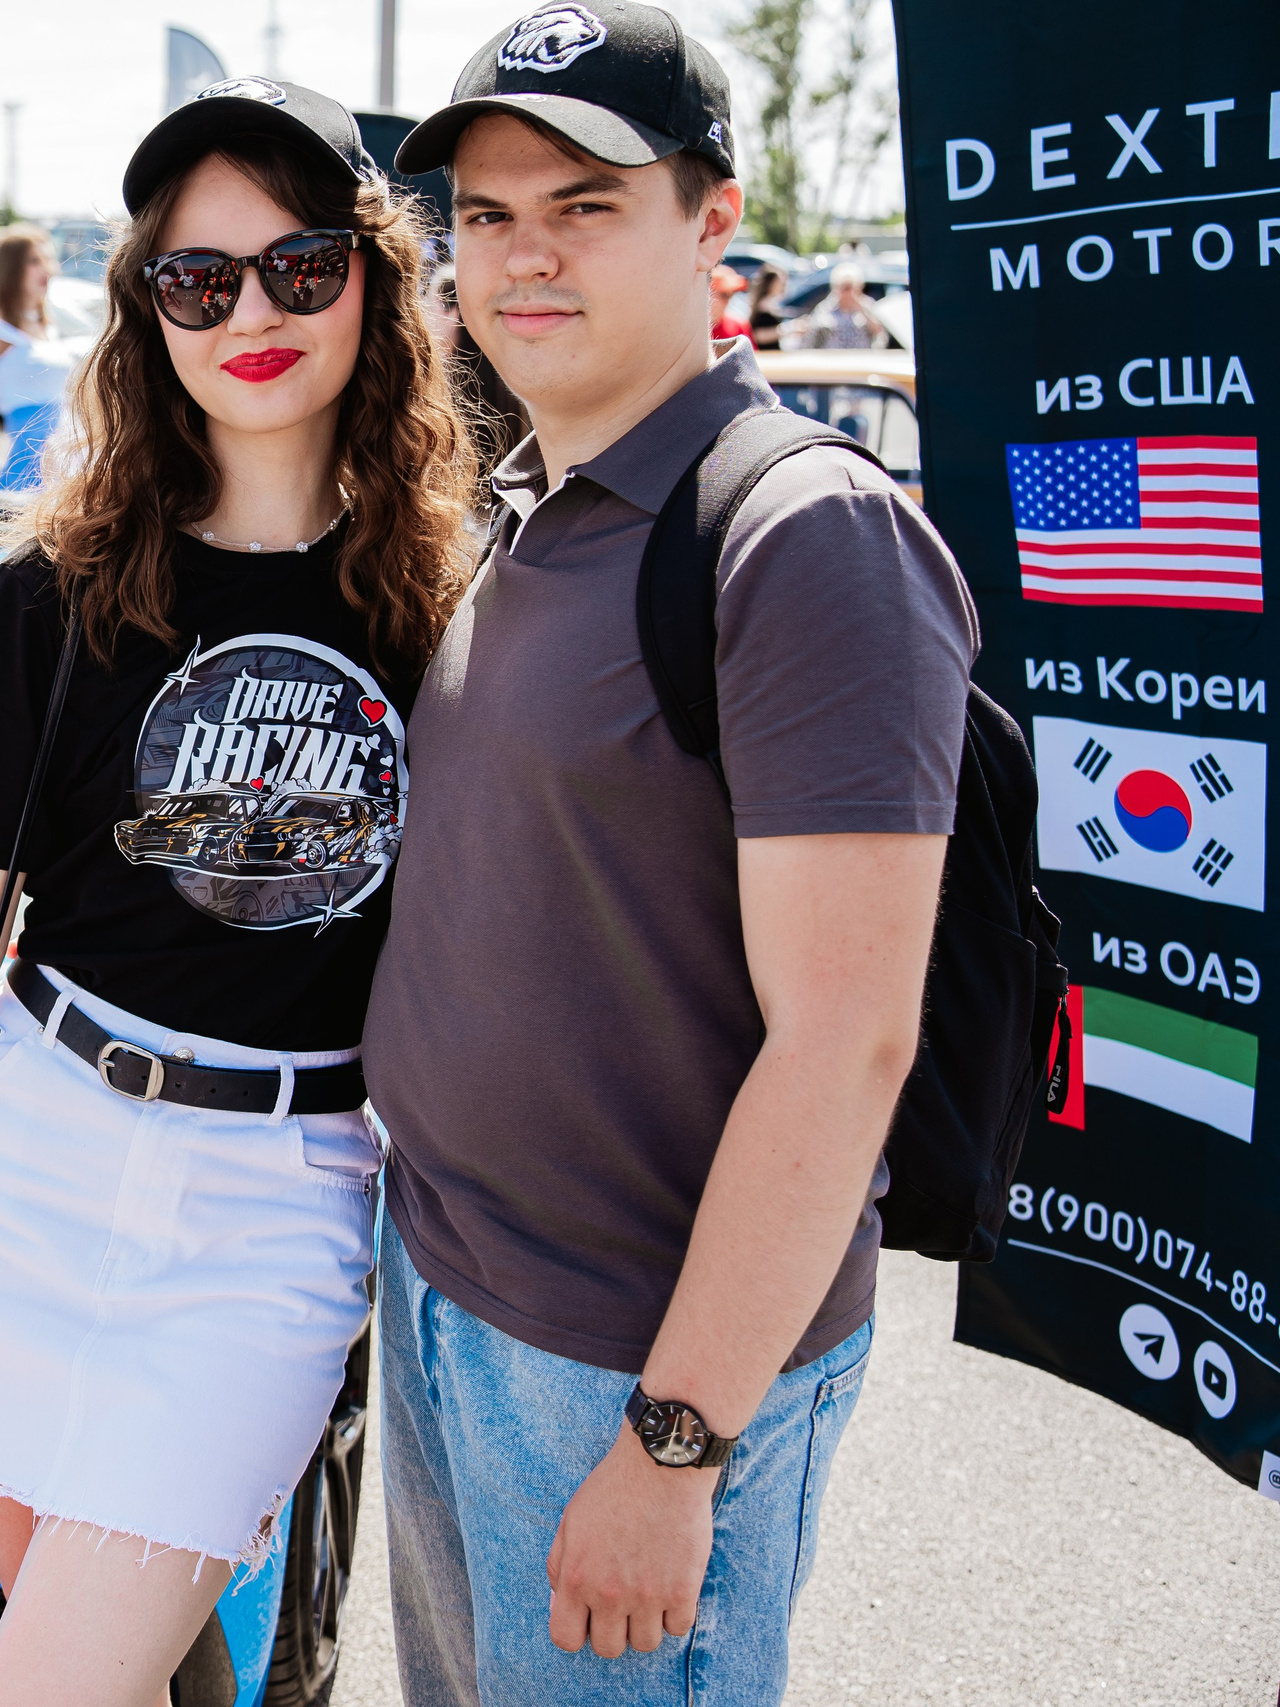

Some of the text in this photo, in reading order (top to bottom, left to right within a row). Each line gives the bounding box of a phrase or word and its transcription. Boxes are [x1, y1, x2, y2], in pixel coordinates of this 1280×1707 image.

[946, 91, 1280, 201] DEXT
[1036, 356, 1255, 414] из США
[221, 667, 344, 724] DRIVE
[1025, 656, 1266, 720] из Кореи
[161, 709, 374, 797] RACING
[1092, 932, 1261, 1004] из ОАЭ
[1008, 1183, 1280, 1340] 8(900)074-88-
